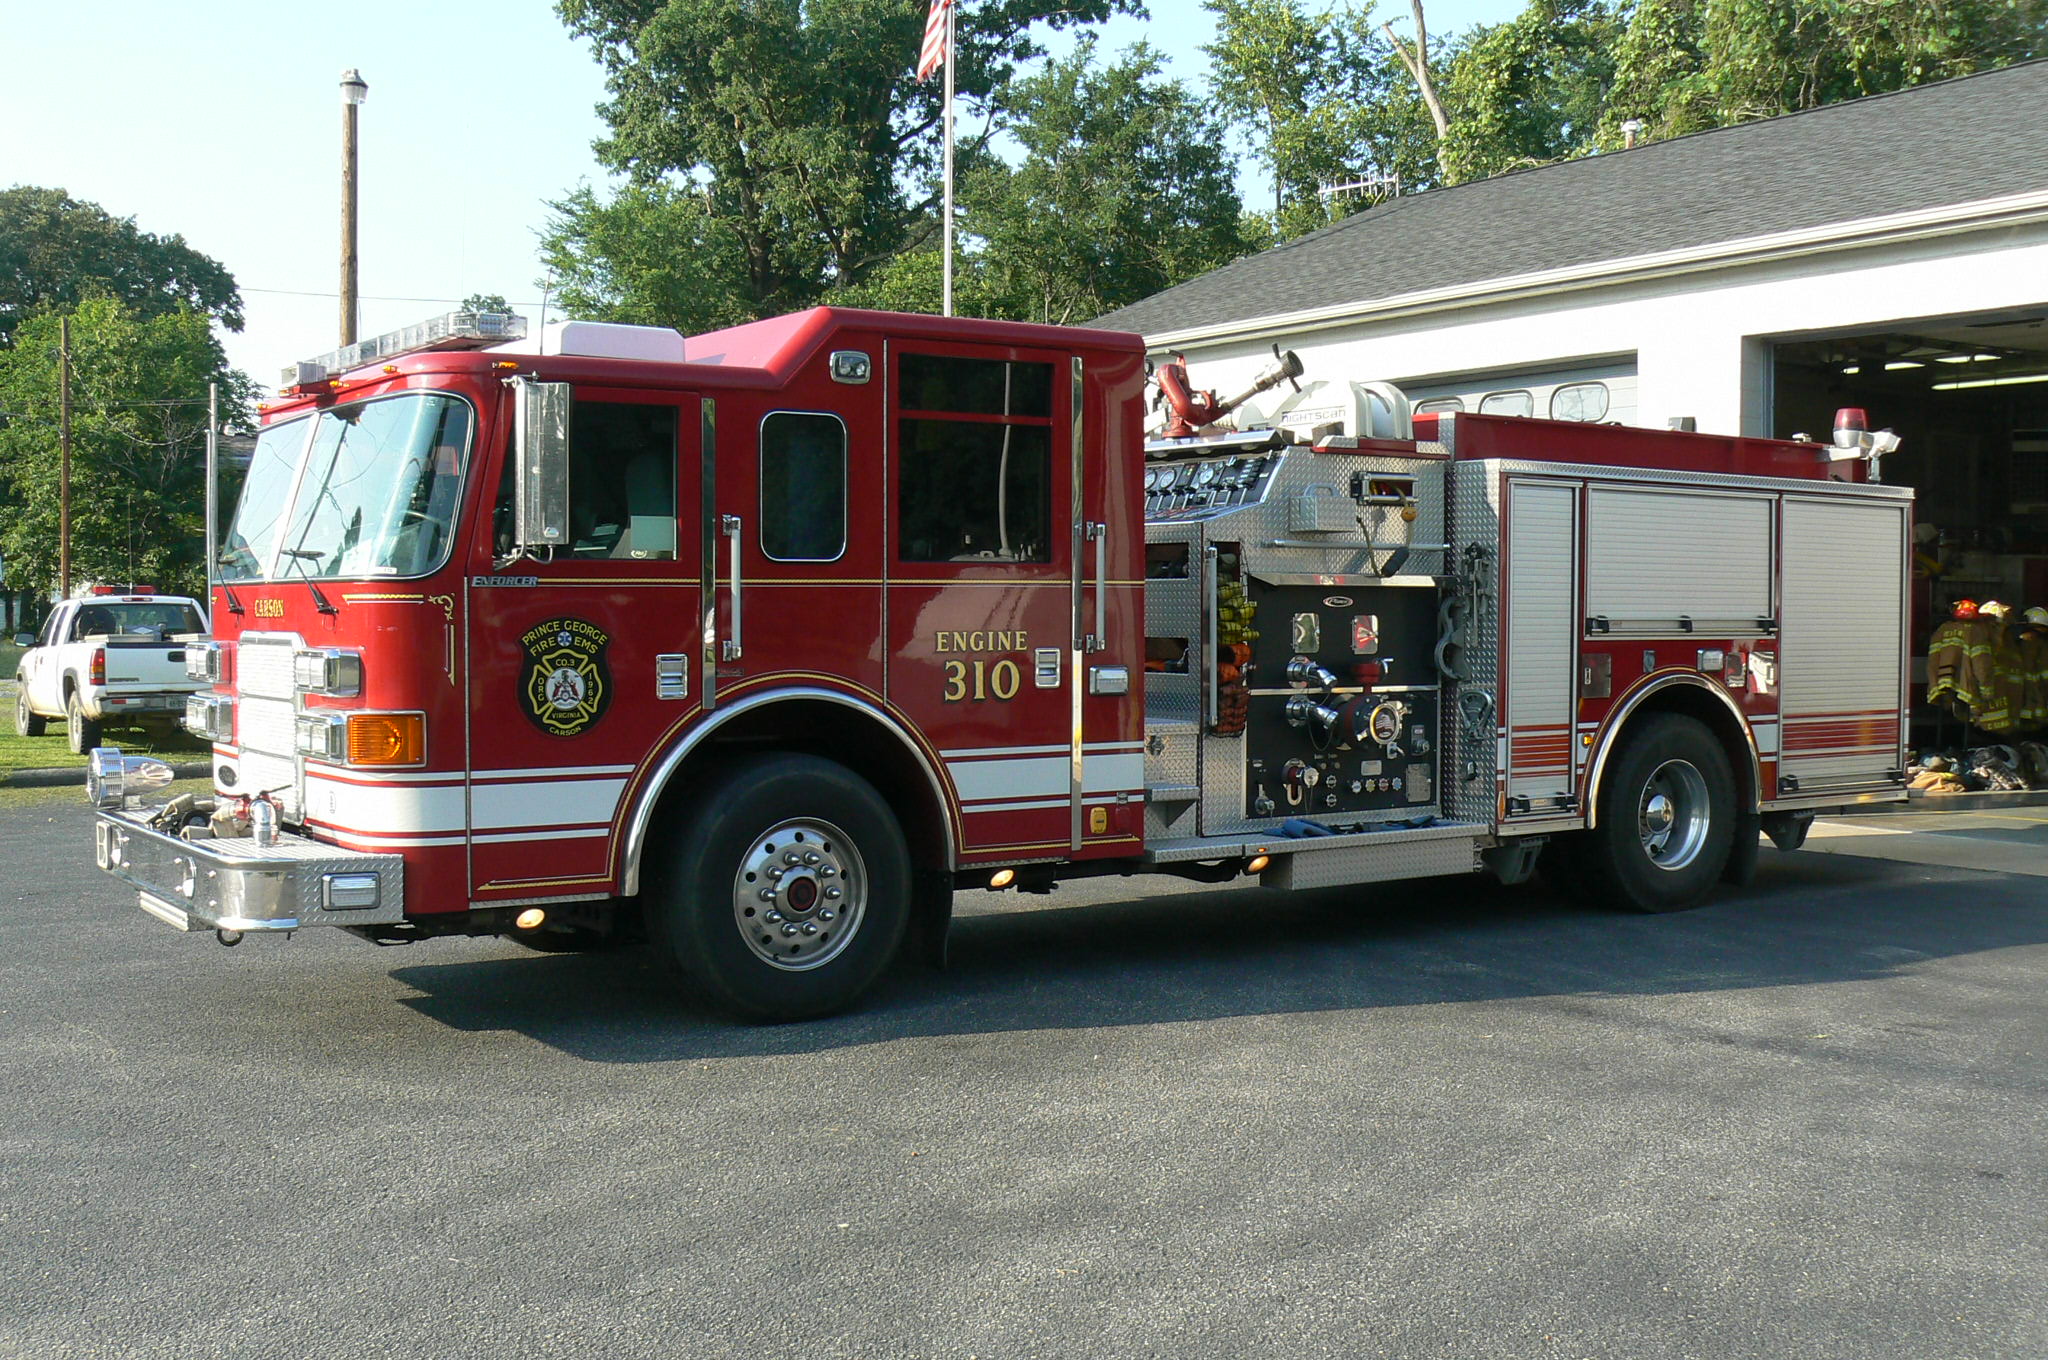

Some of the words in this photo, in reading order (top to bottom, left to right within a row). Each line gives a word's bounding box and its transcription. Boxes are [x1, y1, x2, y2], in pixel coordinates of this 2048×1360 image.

[473, 576, 538, 586] ENFORCER
[254, 599, 284, 617] CARSON
[521, 620, 561, 646] PRINCE
[563, 620, 608, 645] GEORGE
[936, 631, 1028, 652] ENGINE
[529, 636, 557, 657] FIRE
[574, 636, 599, 654] EMS
[587, 672, 595, 705] 1962
[944, 659, 1020, 701] 310
[551, 711, 582, 719] VIRGINIA
[549, 725, 582, 736] CARSON
